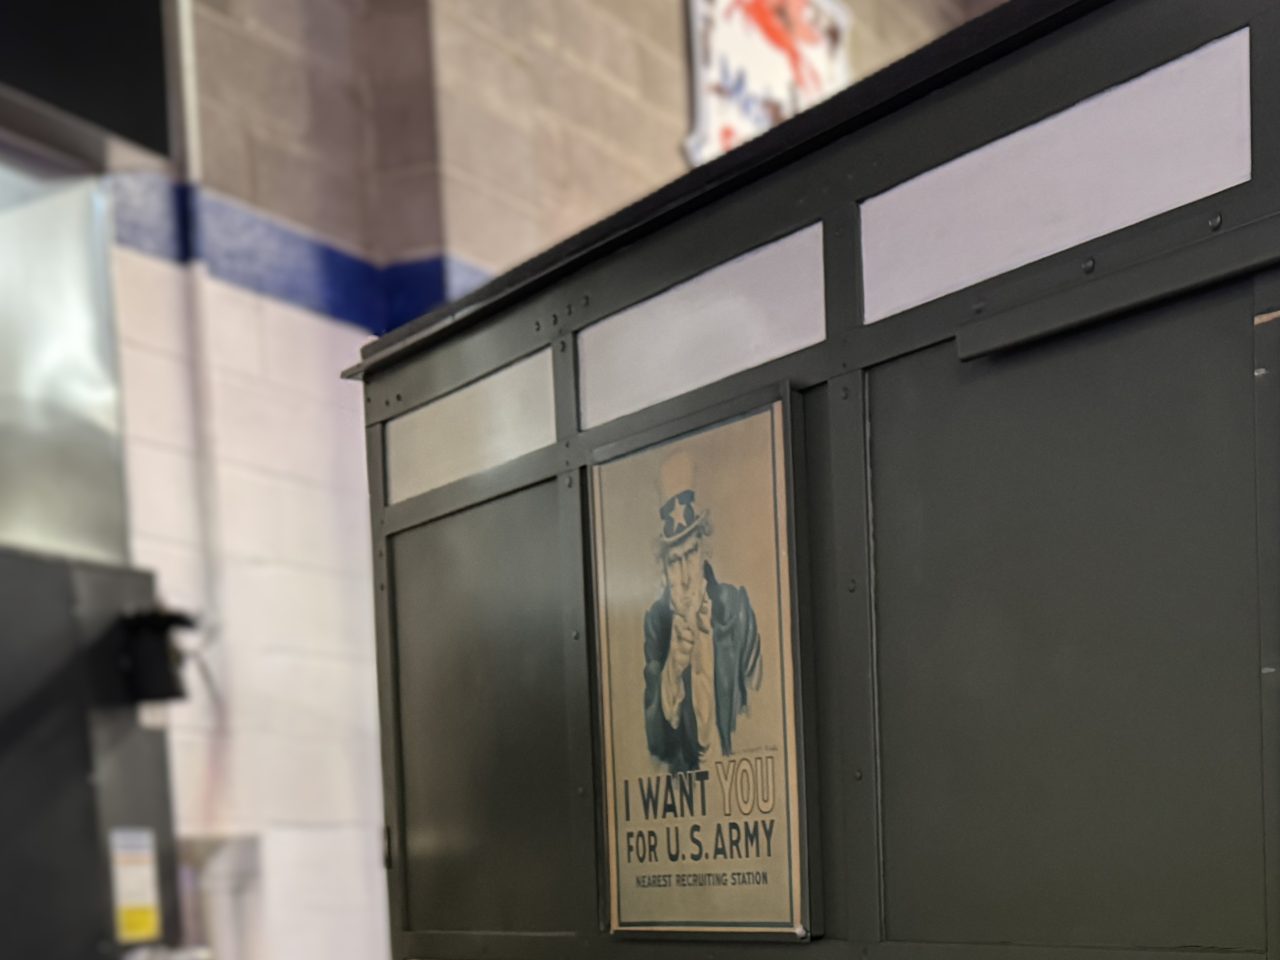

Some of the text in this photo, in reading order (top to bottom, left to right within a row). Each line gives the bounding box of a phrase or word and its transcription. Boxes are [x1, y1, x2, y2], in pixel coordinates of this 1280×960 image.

[624, 756, 775, 821] I WANT YOU
[626, 830, 659, 863] FOR
[636, 871, 768, 888] NEAREST RECRUITING STATION
